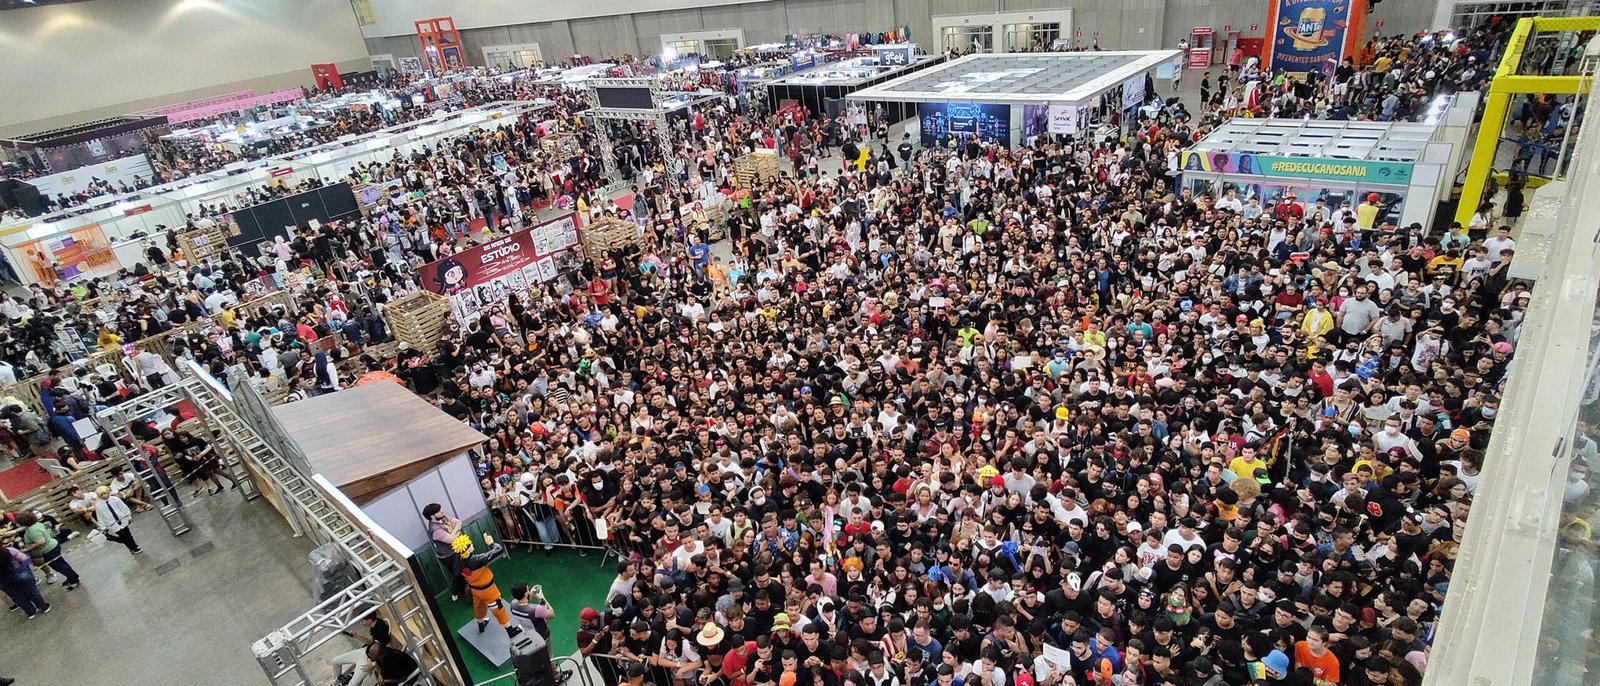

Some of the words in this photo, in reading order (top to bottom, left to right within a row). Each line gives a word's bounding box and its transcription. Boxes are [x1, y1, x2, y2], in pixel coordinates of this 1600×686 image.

[885, 51, 905, 65] geek
[1277, 53, 1309, 64] DIFERENTES
[1271, 161, 1367, 177] #REDECUCANOSANA
[480, 243, 520, 264] ESTÚDIO
